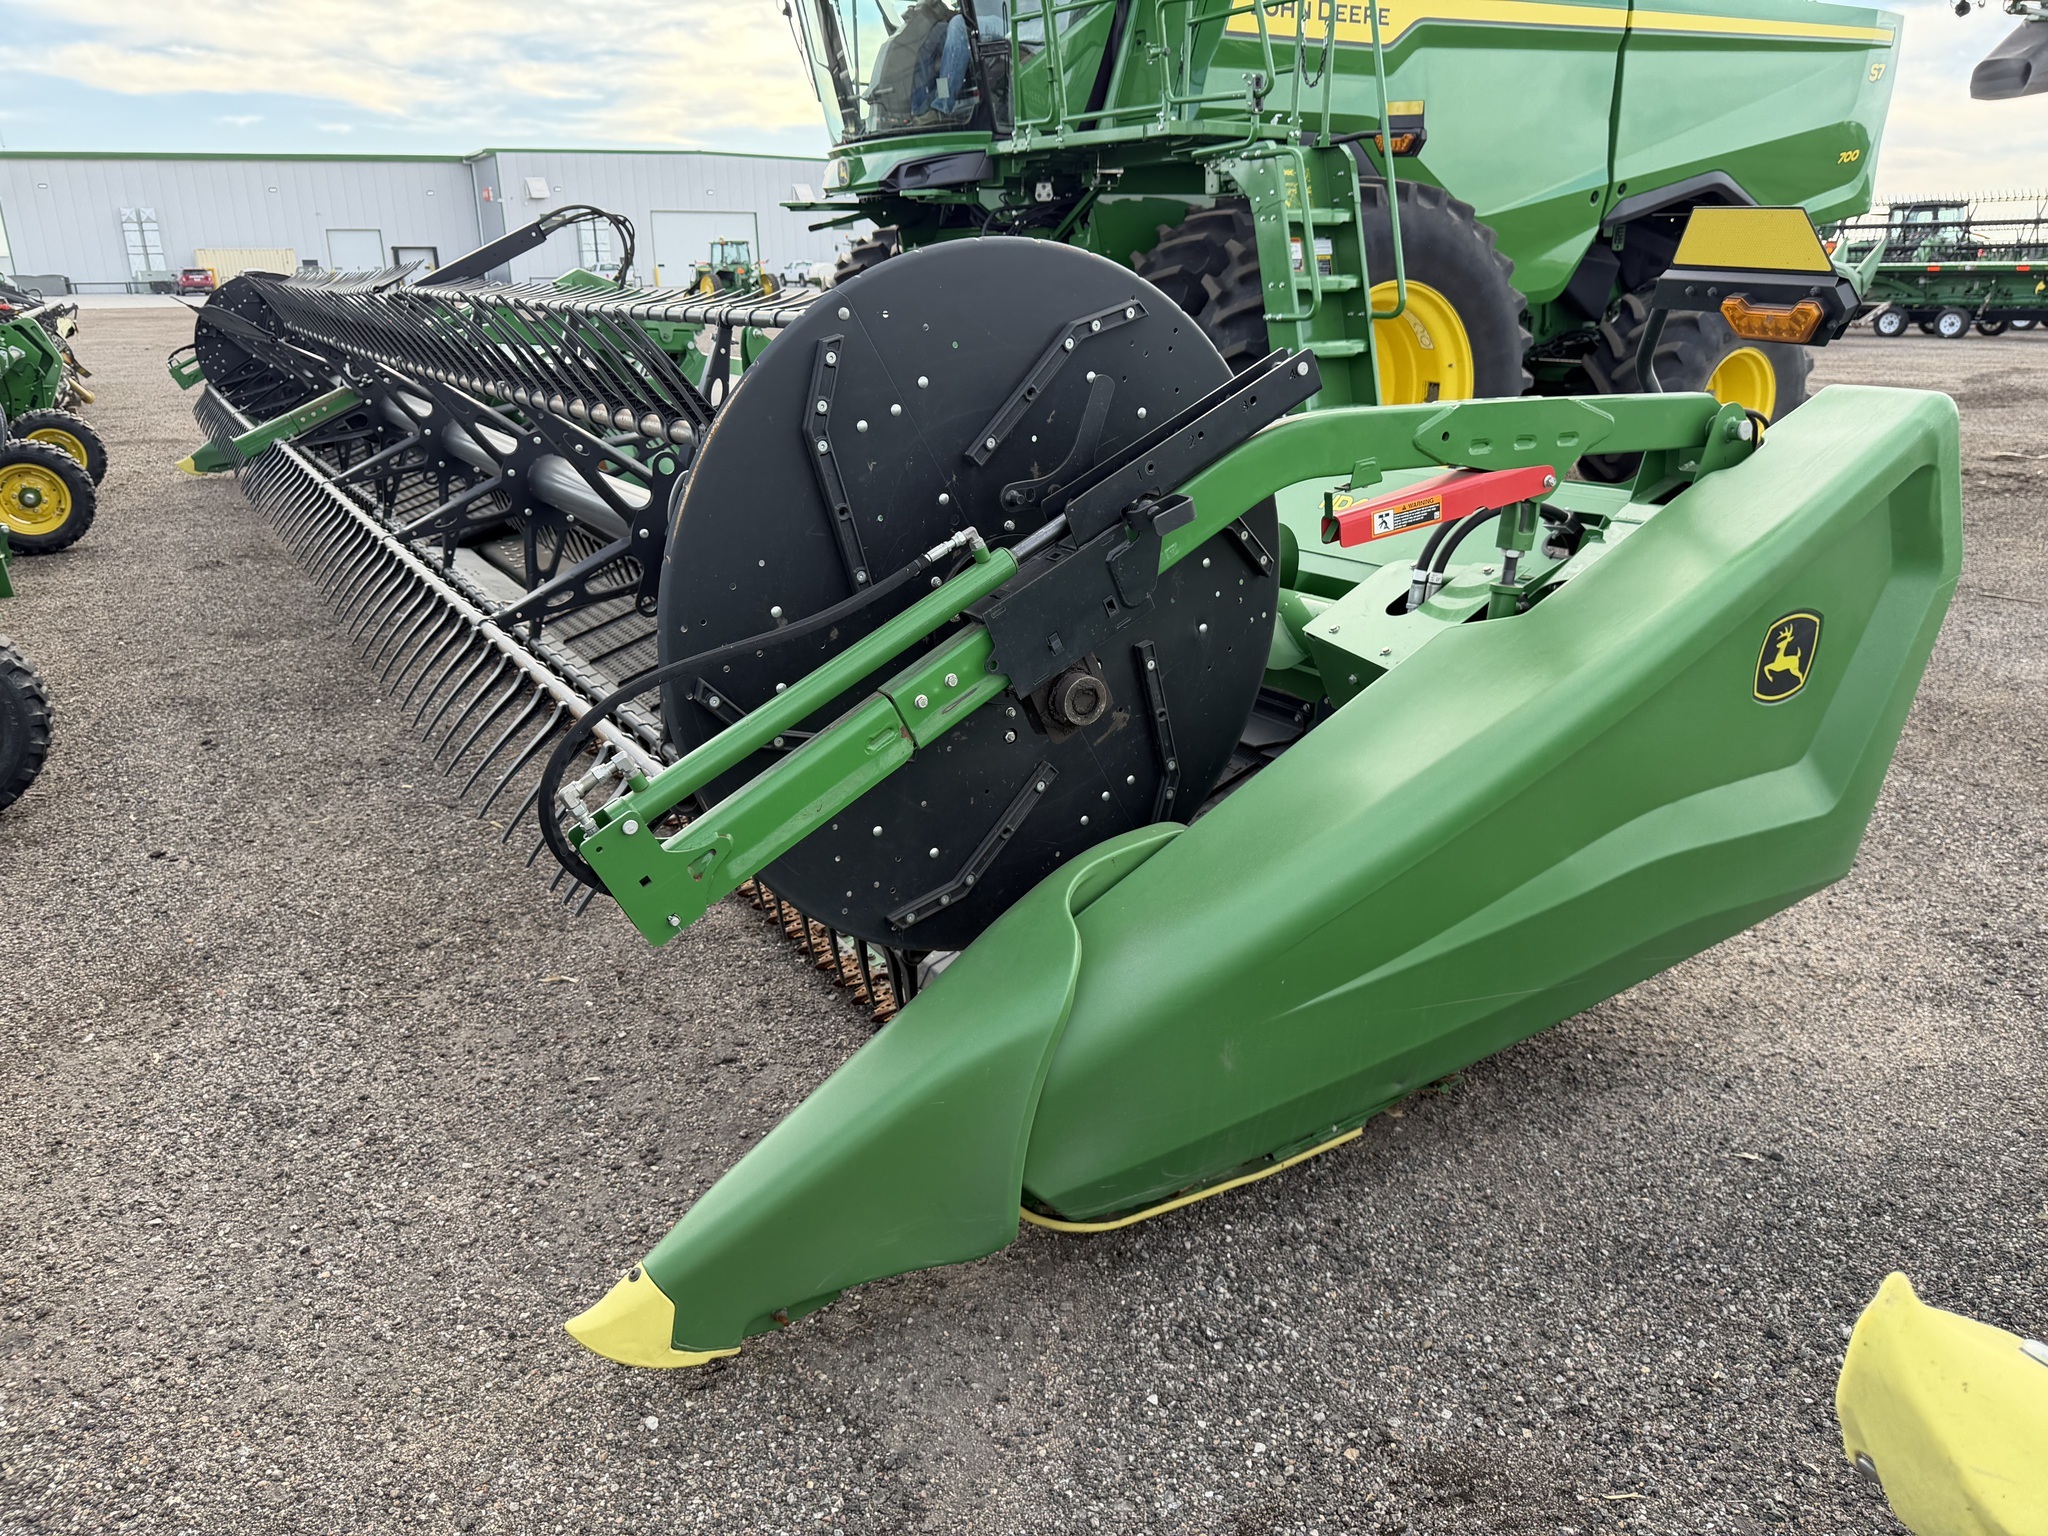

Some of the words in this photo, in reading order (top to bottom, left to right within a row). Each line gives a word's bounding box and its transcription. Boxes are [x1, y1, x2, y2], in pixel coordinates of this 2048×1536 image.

[1251, 0, 1311, 19] OHN
[1869, 63, 1886, 82] S7
[1837, 149, 1860, 165] 700
[1407, 498, 1434, 509] WARNING
